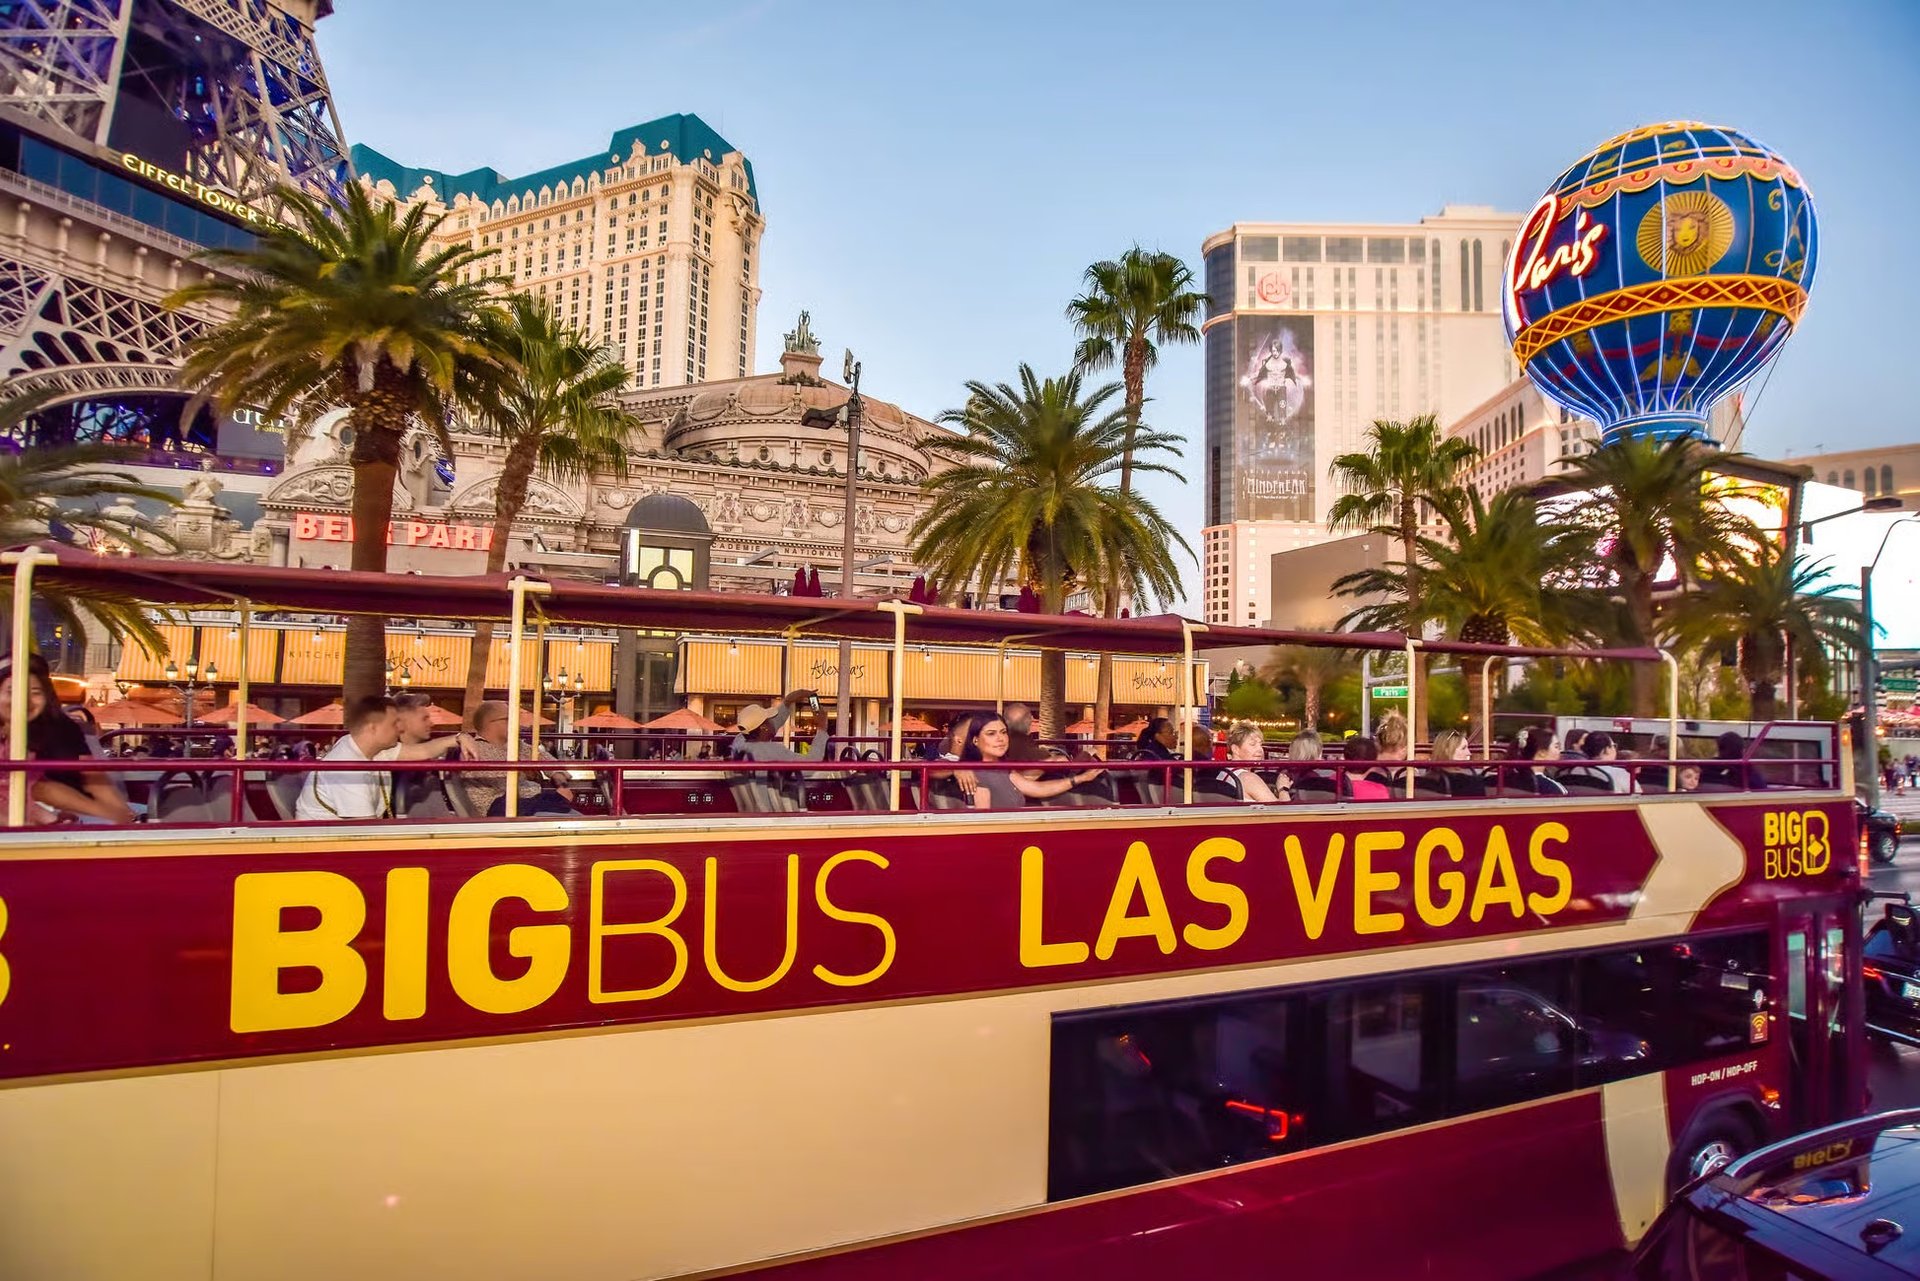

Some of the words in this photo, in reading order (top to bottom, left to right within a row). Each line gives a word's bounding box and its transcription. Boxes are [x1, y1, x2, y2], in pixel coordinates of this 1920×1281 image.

[121, 153, 190, 194] EIFFEL
[194, 183, 257, 223] TOWER
[1507, 193, 1606, 331] Paris
[711, 542, 761, 552] CADEMIE
[784, 548, 845, 558] NATIONAL
[288, 651, 341, 659] KITCHE
[1764, 811, 1802, 846] BIG
[1765, 847, 1802, 879] BUS
[1019, 837, 1250, 968] LAS
[1283, 822, 1573, 941] VEGAS
[1691, 1069, 1720, 1086] HOP-ON
[1726, 1060, 1758, 1077] HOP-OFF
